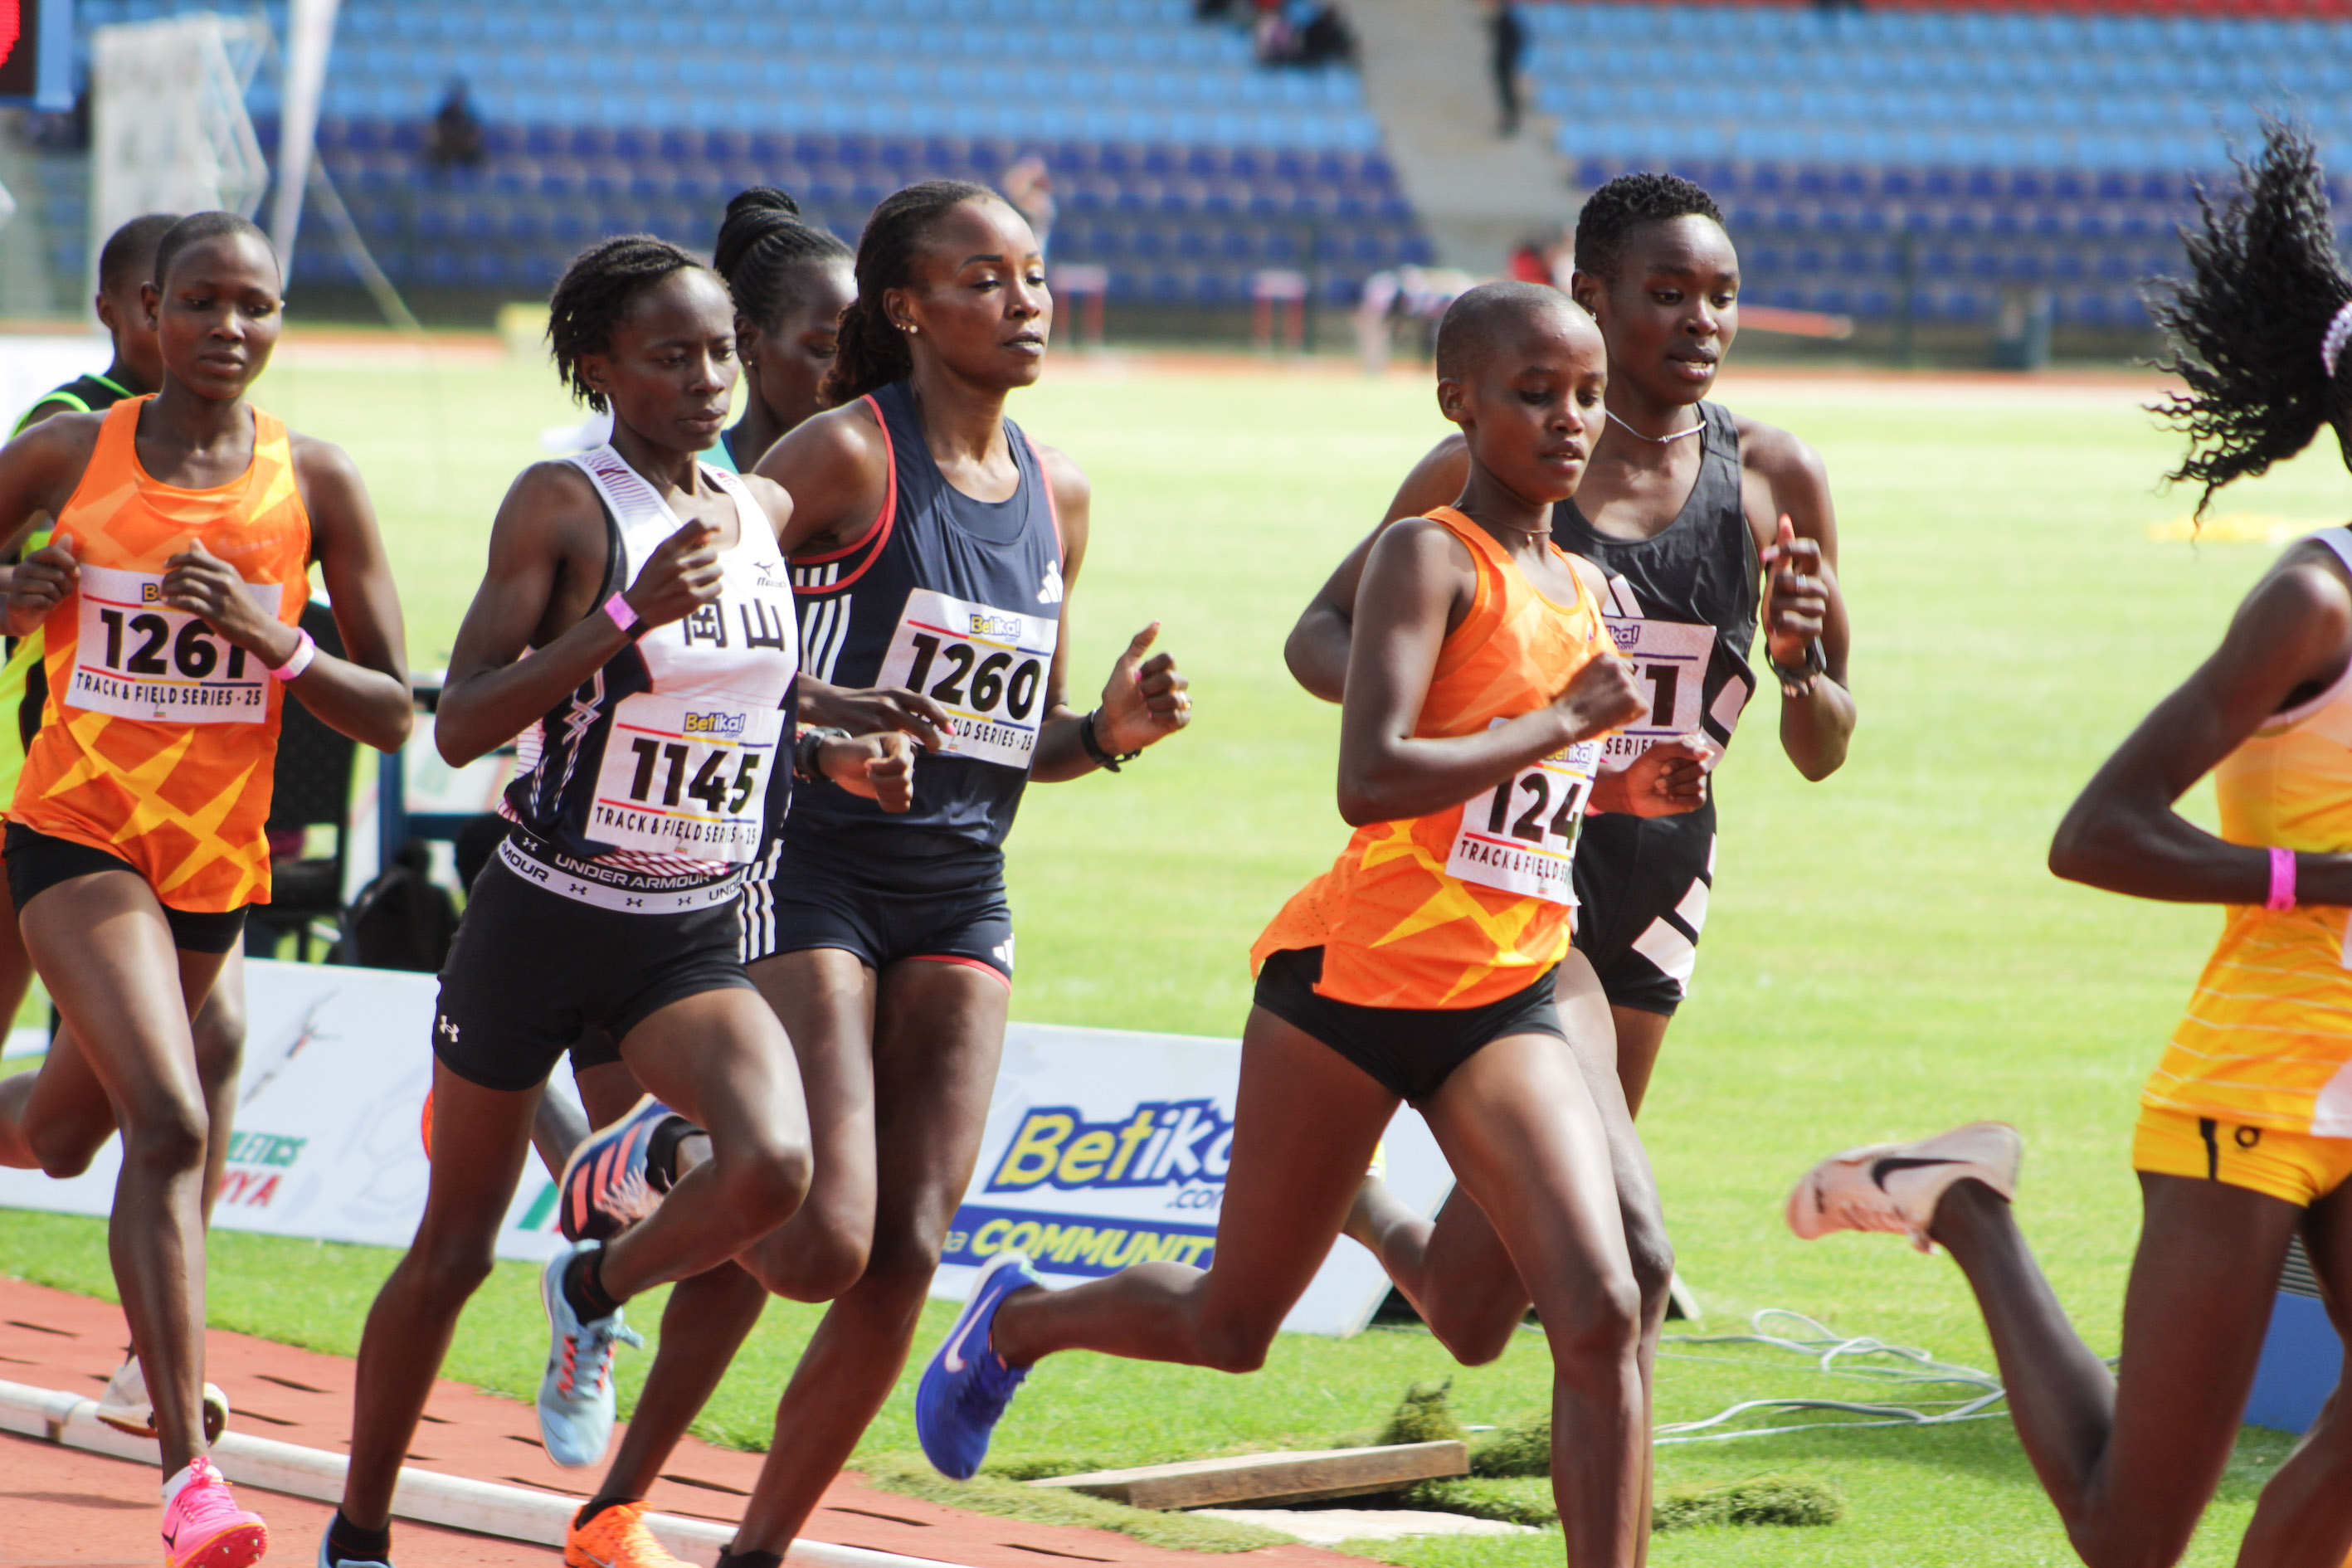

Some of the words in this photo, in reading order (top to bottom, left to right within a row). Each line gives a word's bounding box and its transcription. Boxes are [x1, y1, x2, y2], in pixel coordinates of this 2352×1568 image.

[100, 608, 246, 679] 1261
[75, 673, 119, 698] TRACK
[122, 684, 129, 700] &
[135, 685, 177, 704] FIELD
[182, 688, 233, 705] SERIES
[244, 689, 262, 705] 25
[906, 632, 1040, 720] 1260
[684, 713, 746, 733] Betika!
[974, 723, 1015, 747] SERIES
[1020, 734, 1033, 751] 25
[1544, 742, 1593, 764] etika!
[631, 738, 761, 814] 1145
[596, 806, 647, 833] TRACK
[650, 818, 660, 835] &
[663, 819, 702, 840] FIELD
[746, 827, 756, 845] 25
[1488, 772, 1585, 850] 124
[501, 841, 549, 883] MOUR
[555, 853, 628, 885] UNDER
[630, 872, 712, 889] ARMOUR
[1460, 840, 1512, 869] TRACK
[1513, 854, 1520, 871] &
[1523, 855, 1559, 879] FIELD
[1166, 1188, 1224, 1208] .co
[971, 1219, 1216, 1269] COMMUNIT
